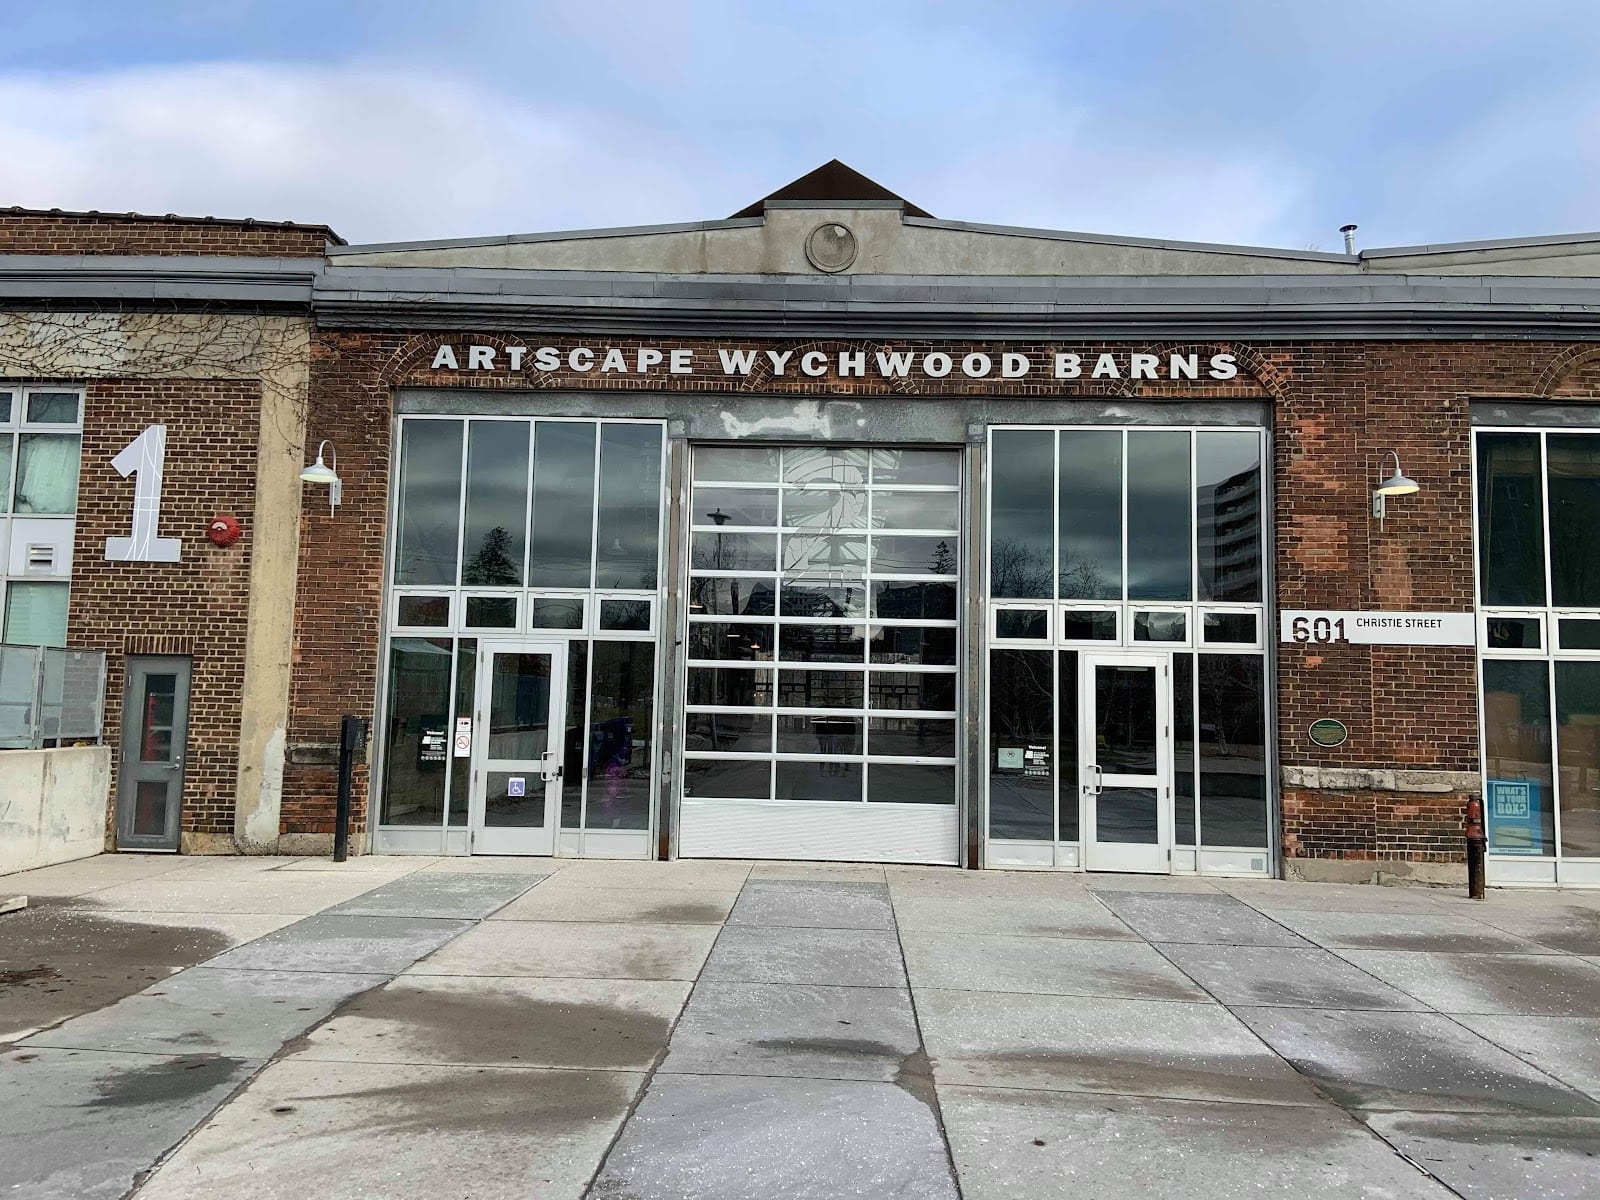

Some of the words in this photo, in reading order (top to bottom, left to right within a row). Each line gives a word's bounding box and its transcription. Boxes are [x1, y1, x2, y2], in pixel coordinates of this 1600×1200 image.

[431, 344, 694, 374] ARTSCAPE
[719, 349, 1031, 379] WYCHWOOD
[1054, 352, 1238, 381] BARNS
[104, 424, 182, 563] 1
[784, 456, 866, 588] 2
[1292, 616, 1349, 644] 601
[1356, 617, 1403, 628] CHRISTIE
[1405, 618, 1442, 629] STREET
[1496, 795, 1505, 803] IN
[1506, 795, 1526, 804] YOUR
[1497, 786, 1526, 795] WHAT'S
[1497, 803, 1526, 814] BOX?
